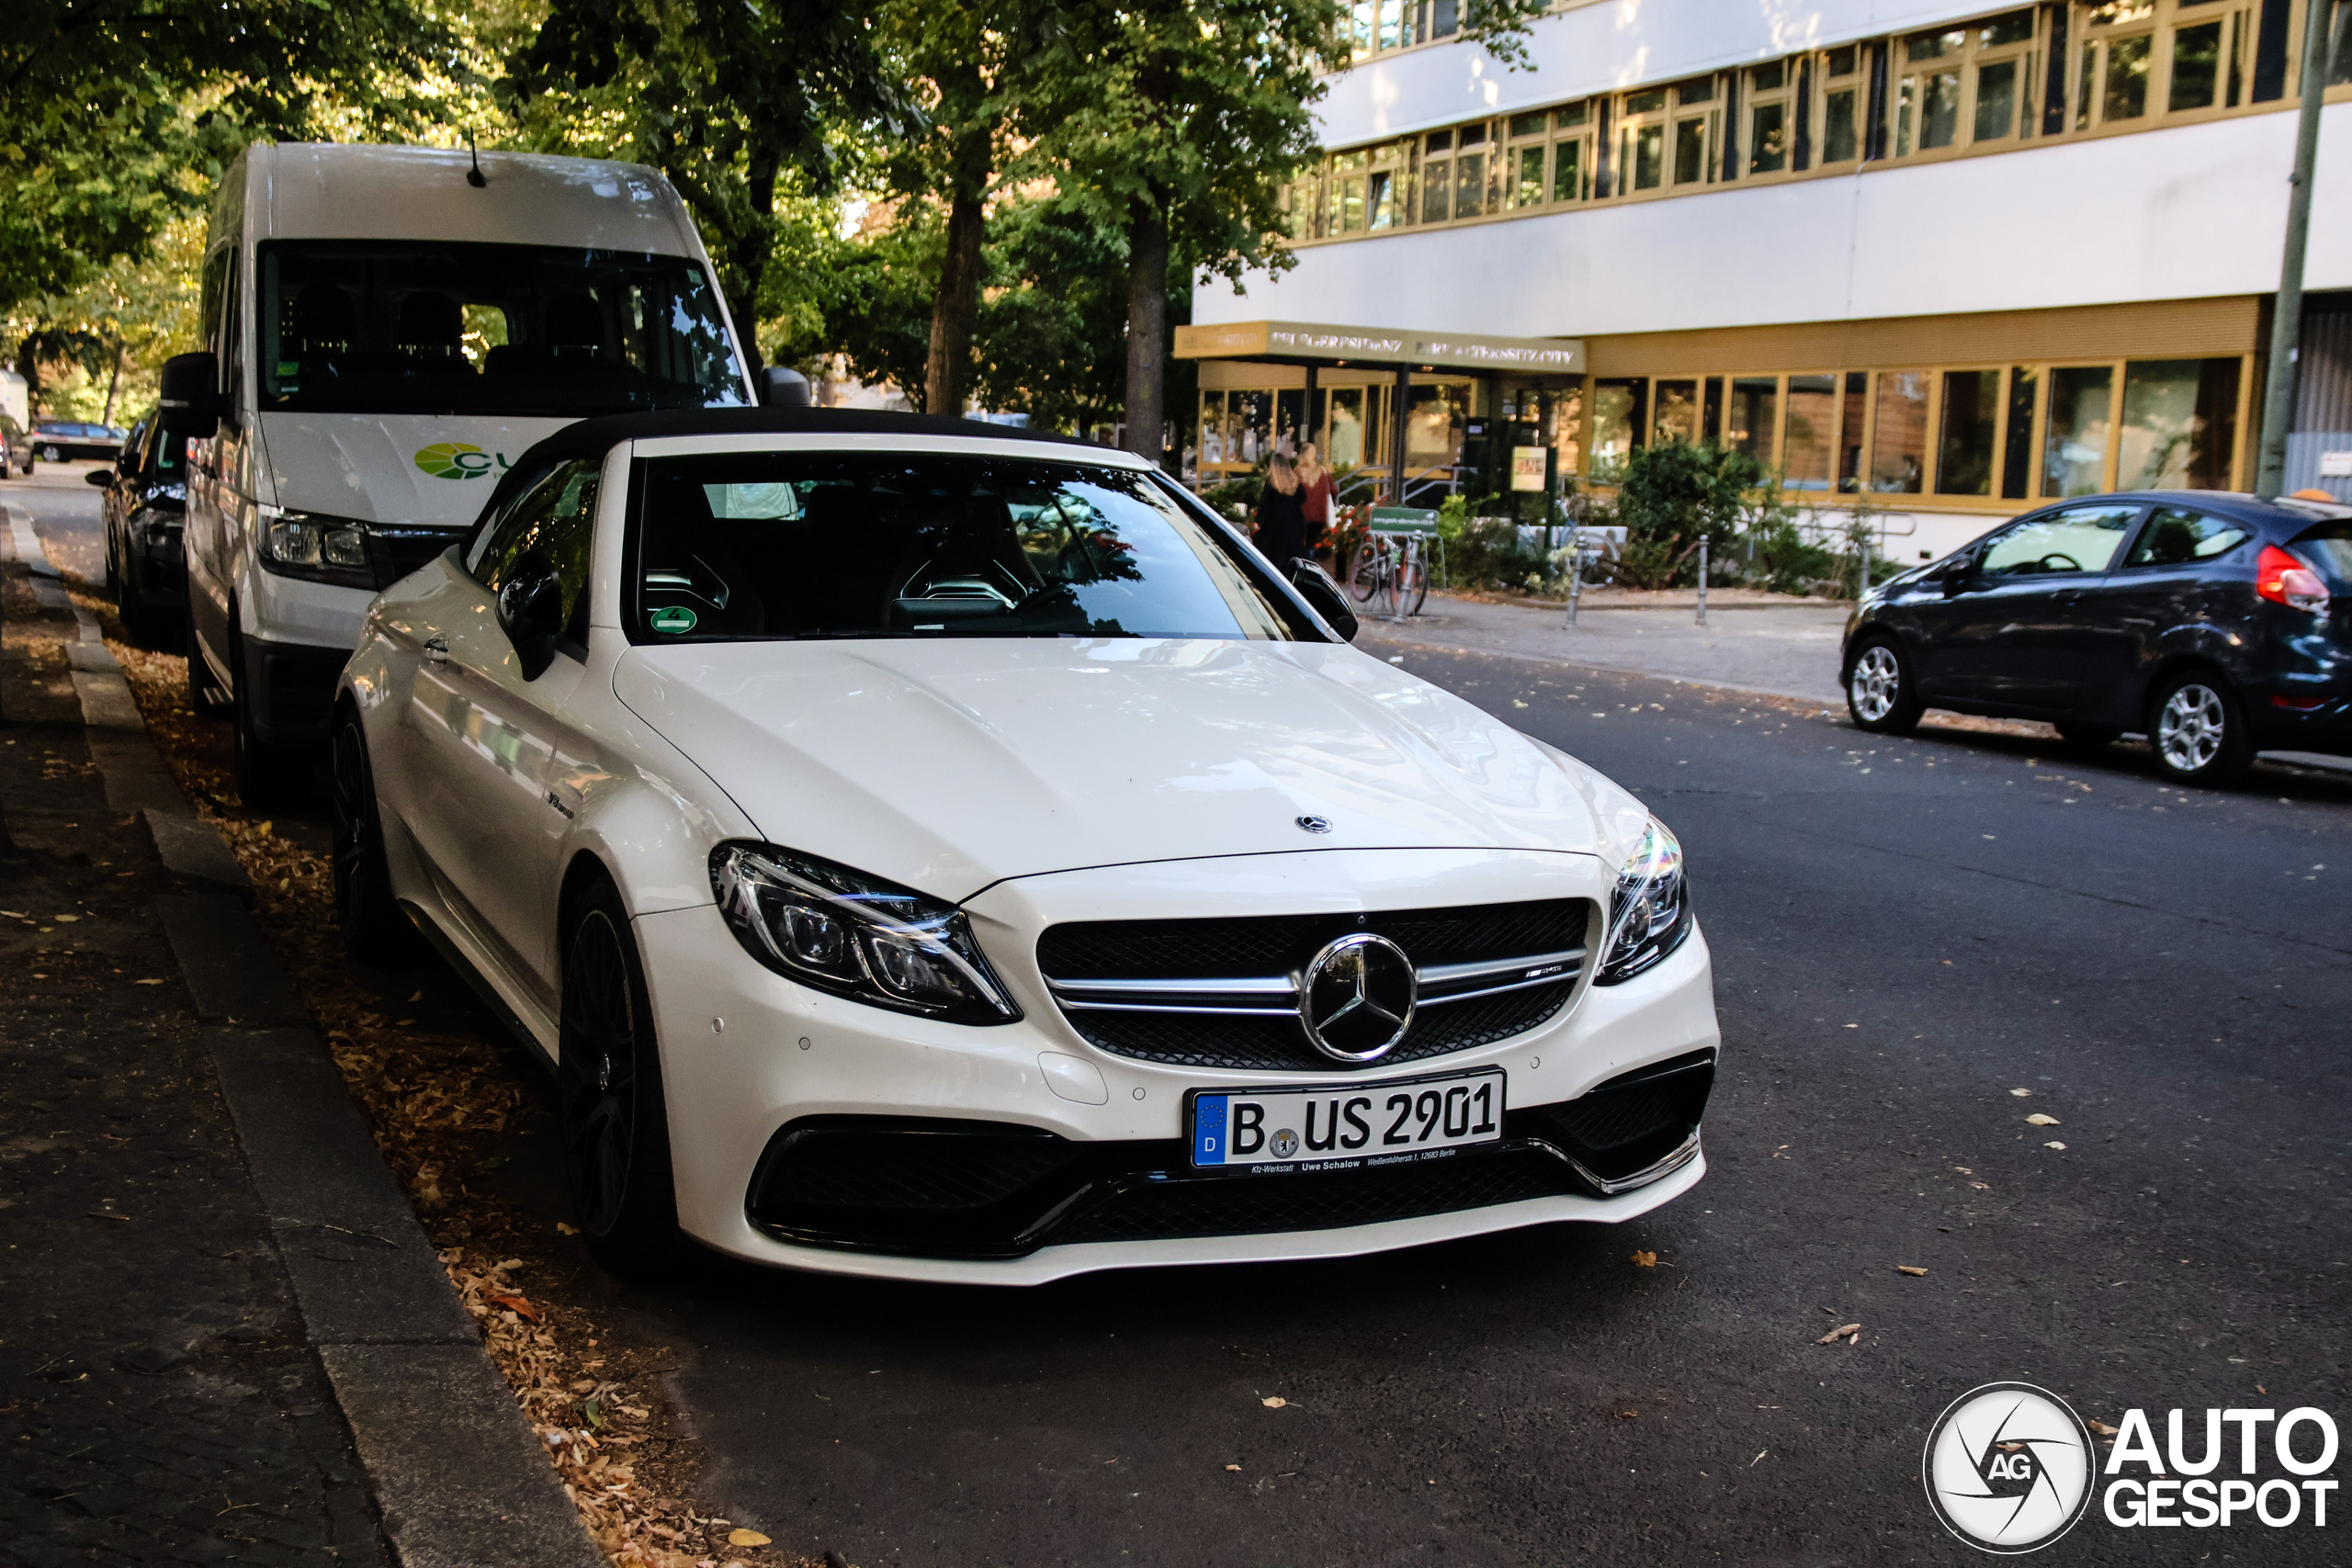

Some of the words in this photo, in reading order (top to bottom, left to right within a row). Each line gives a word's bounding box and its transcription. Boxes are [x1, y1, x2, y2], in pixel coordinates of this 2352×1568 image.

[668, 608, 681, 621] 4
[1232, 1102, 1265, 1155] B
[1305, 1097, 1373, 1151] US
[1383, 1082, 1497, 1145] 2901
[1204, 1137, 1216, 1152] D
[1251, 1164, 1294, 1174] Kfz-Werkstatt
[1302, 1162, 1321, 1171] Uwe
[1323, 1160, 1361, 1170] Schalow
[1439, 1148, 1456, 1157] Berlin
